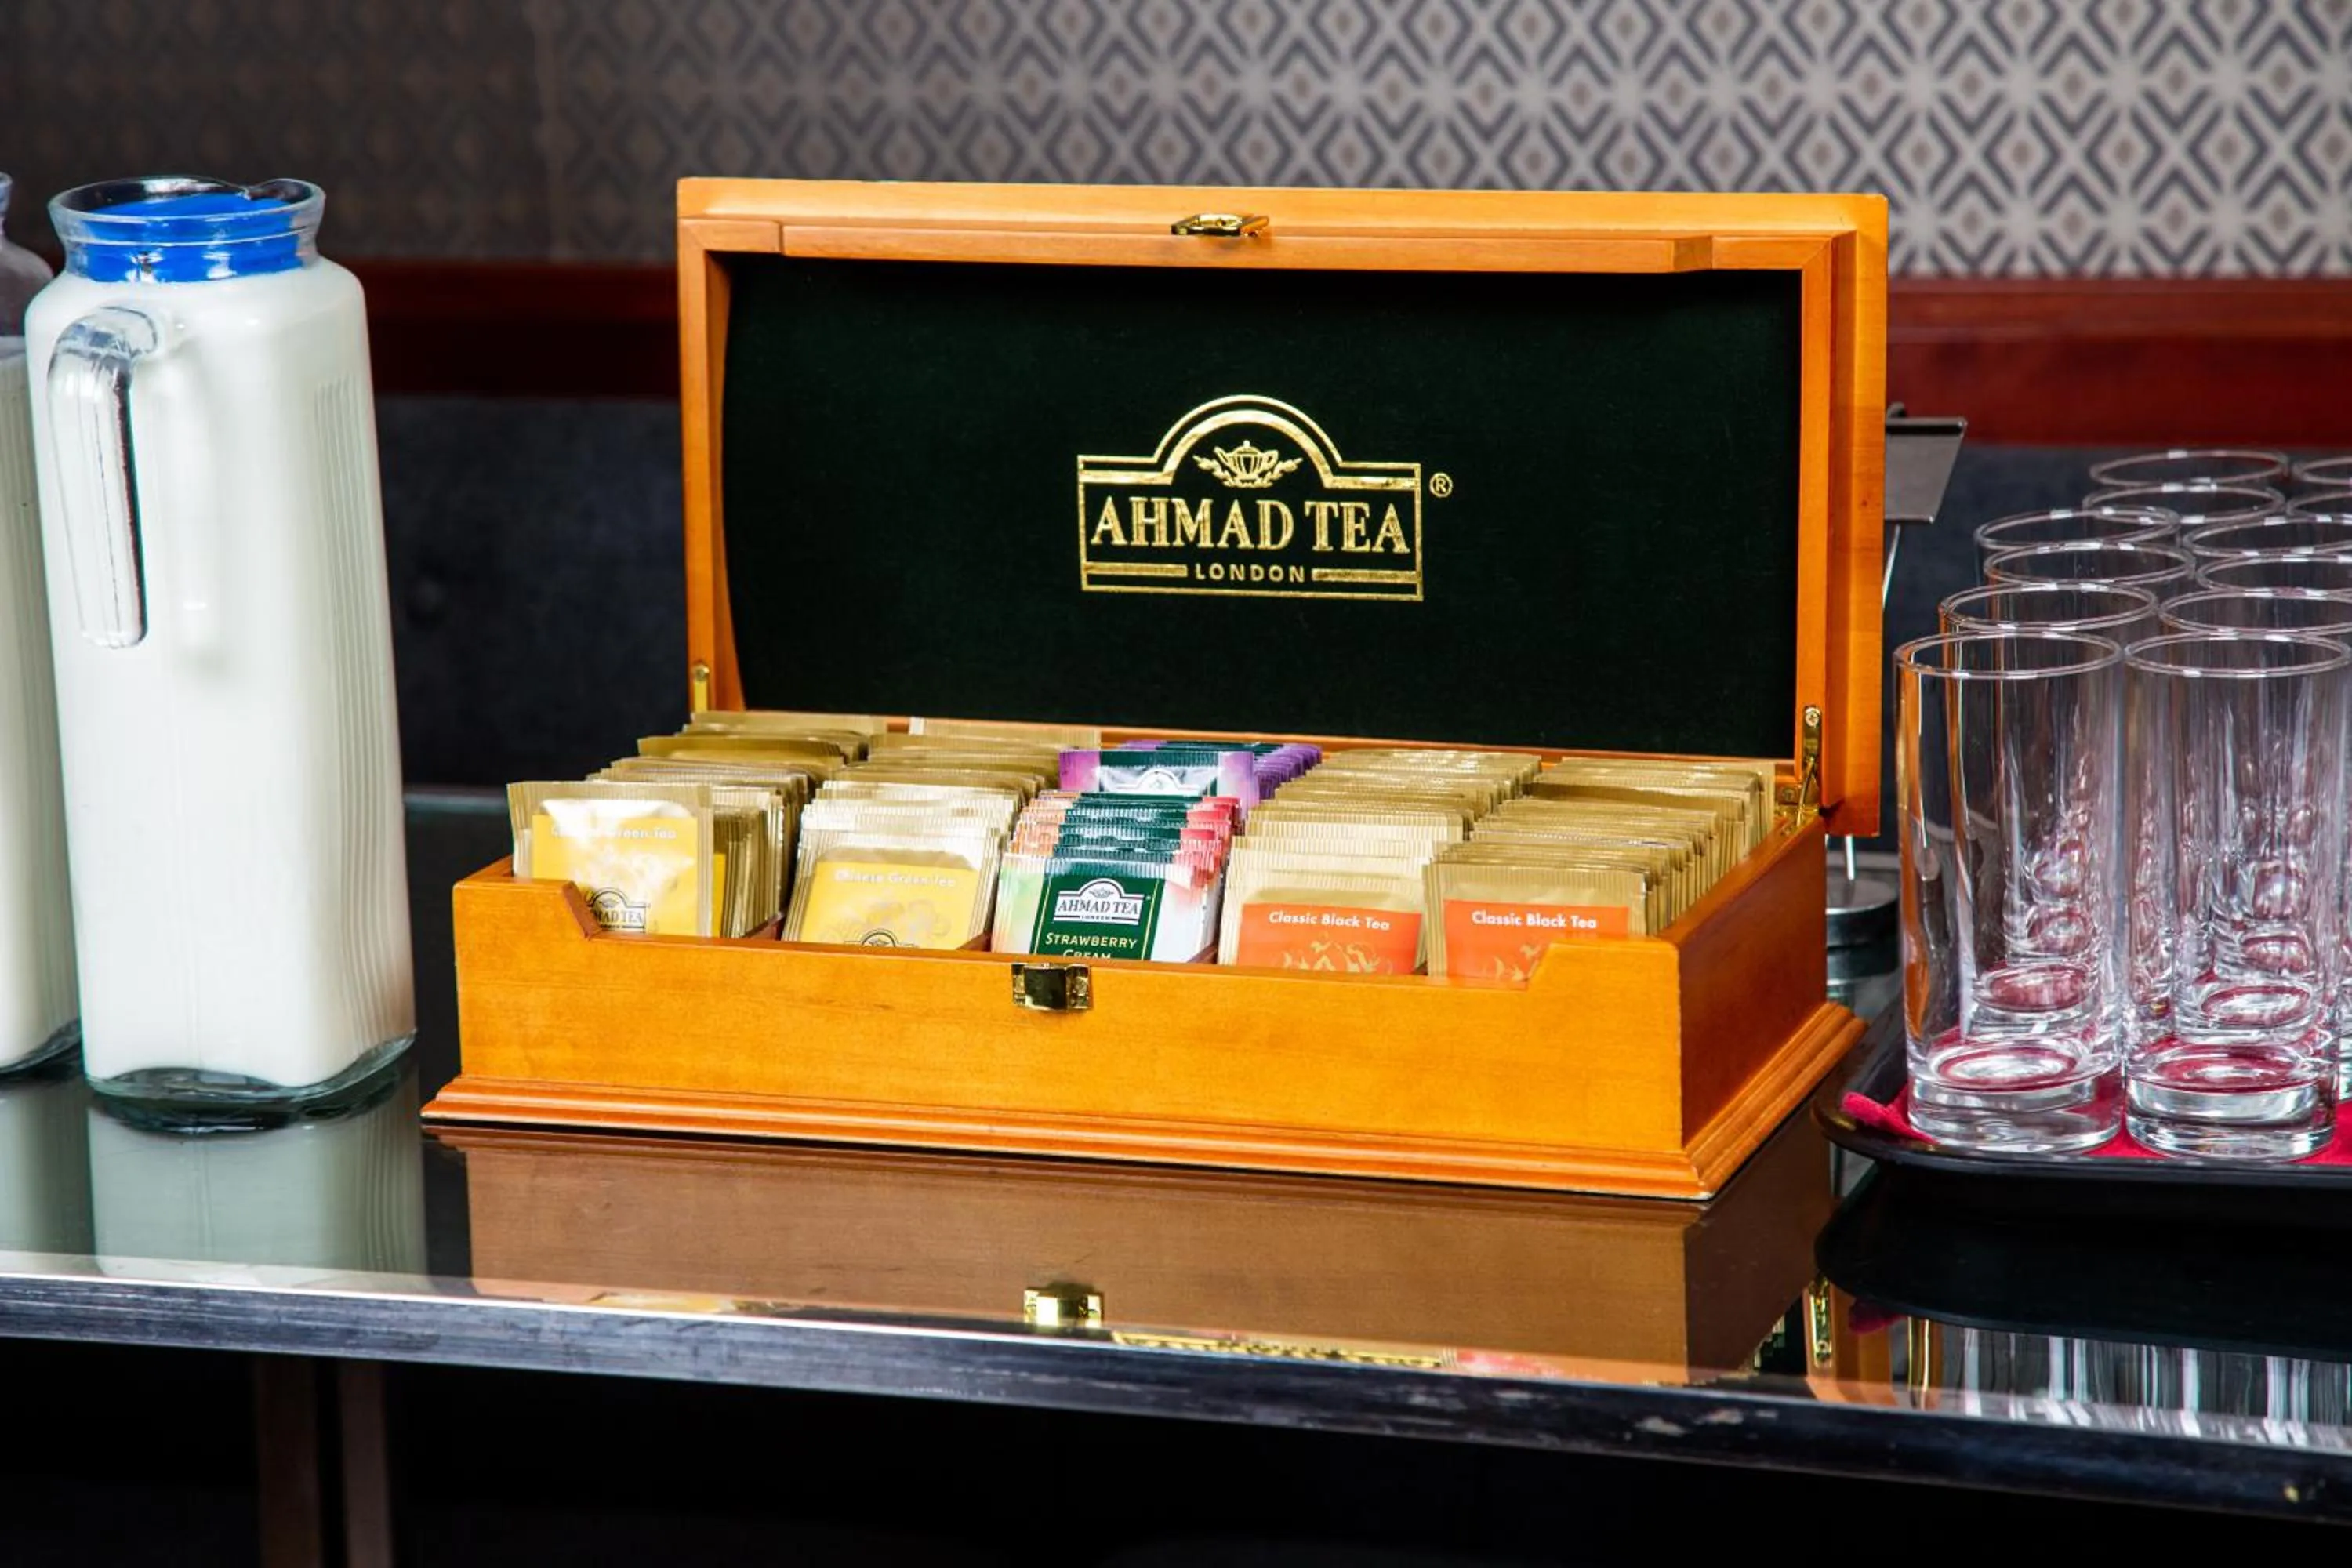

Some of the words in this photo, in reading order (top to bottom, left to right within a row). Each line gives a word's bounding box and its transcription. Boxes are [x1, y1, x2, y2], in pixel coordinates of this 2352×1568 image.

[1090, 496, 1294, 550] AHMAD
[1304, 501, 1410, 553] TEA
[1195, 563, 1305, 583] LONDON
[621, 910, 643, 923] TEA
[1058, 899, 1111, 913] AHMAD
[1112, 901, 1138, 915] TEA
[1269, 909, 1318, 925] Classic
[1321, 912, 1360, 927] Black
[1365, 916, 1391, 931] Tea
[1471, 909, 1523, 925] Classic
[1526, 911, 1566, 927] Black
[1570, 914, 1598, 929] Tea
[1045, 932, 1138, 949] STRAWBERRY
